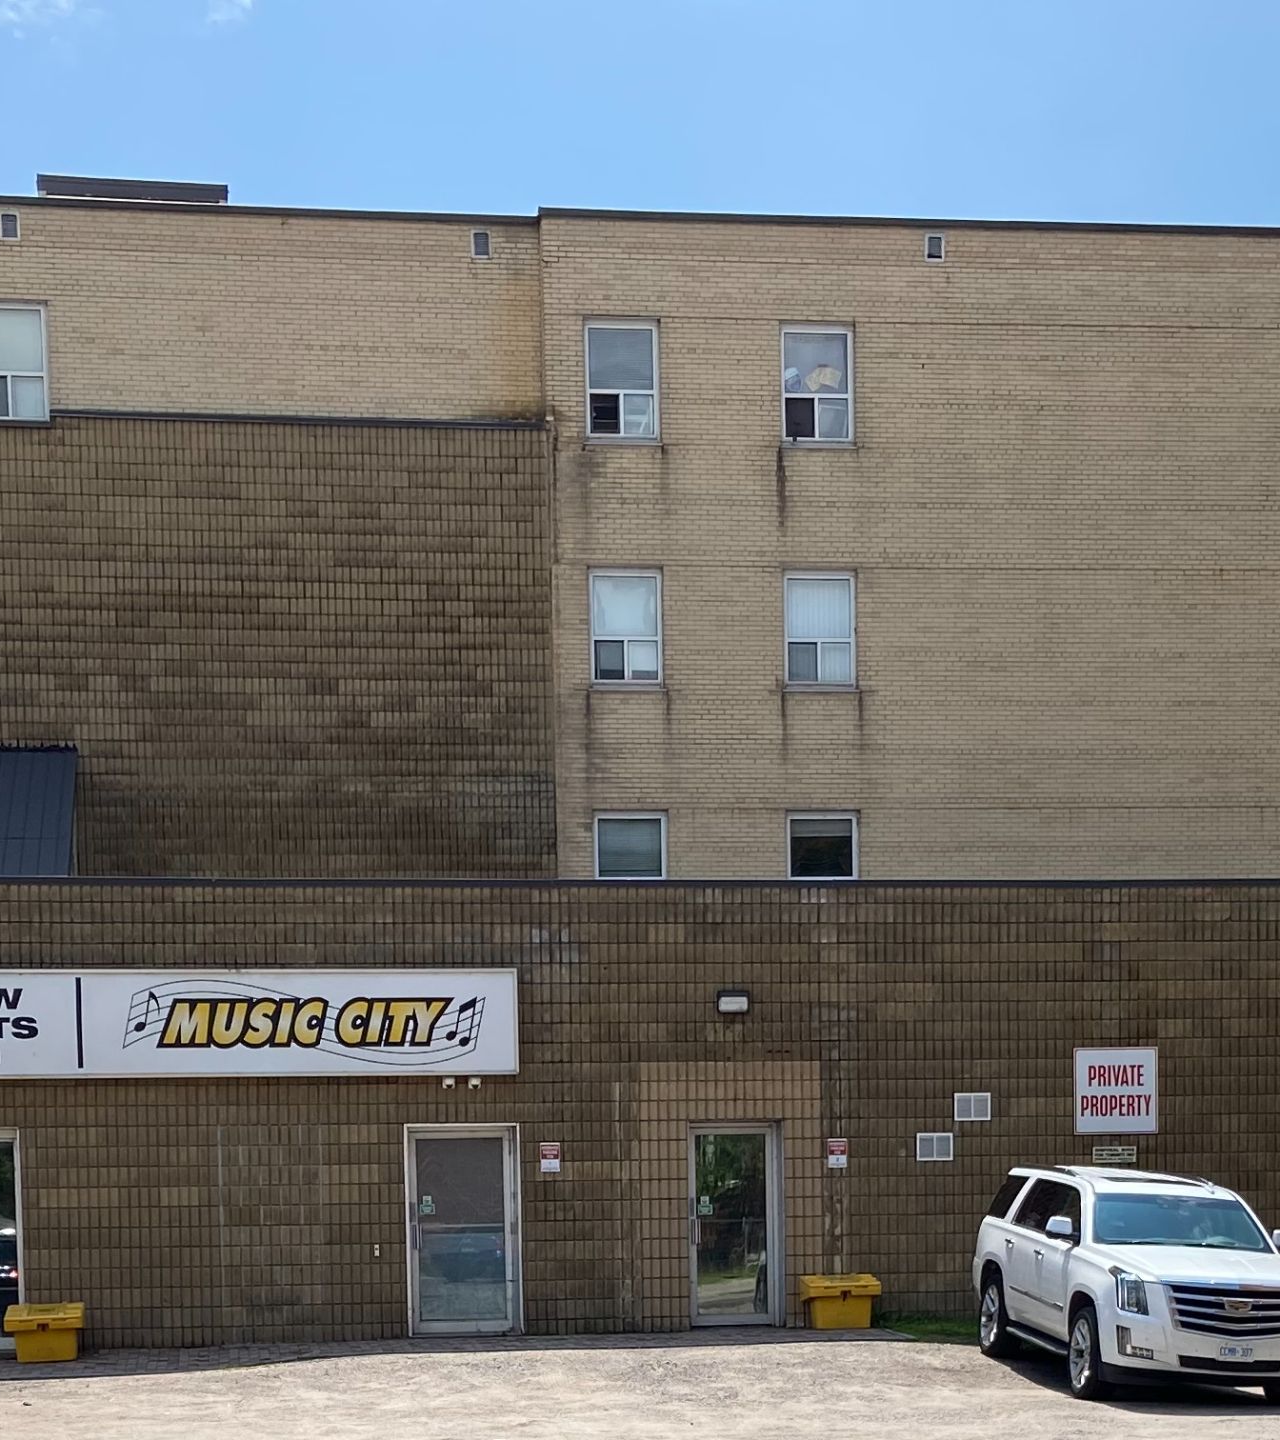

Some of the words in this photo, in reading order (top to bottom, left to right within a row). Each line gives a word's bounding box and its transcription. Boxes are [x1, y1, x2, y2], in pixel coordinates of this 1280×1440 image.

[156, 997, 330, 1049] MUSIC
[334, 997, 456, 1048] CITY
[1087, 1064, 1145, 1088] PRIVATE
[1080, 1094, 1152, 1118] PROPERTY
